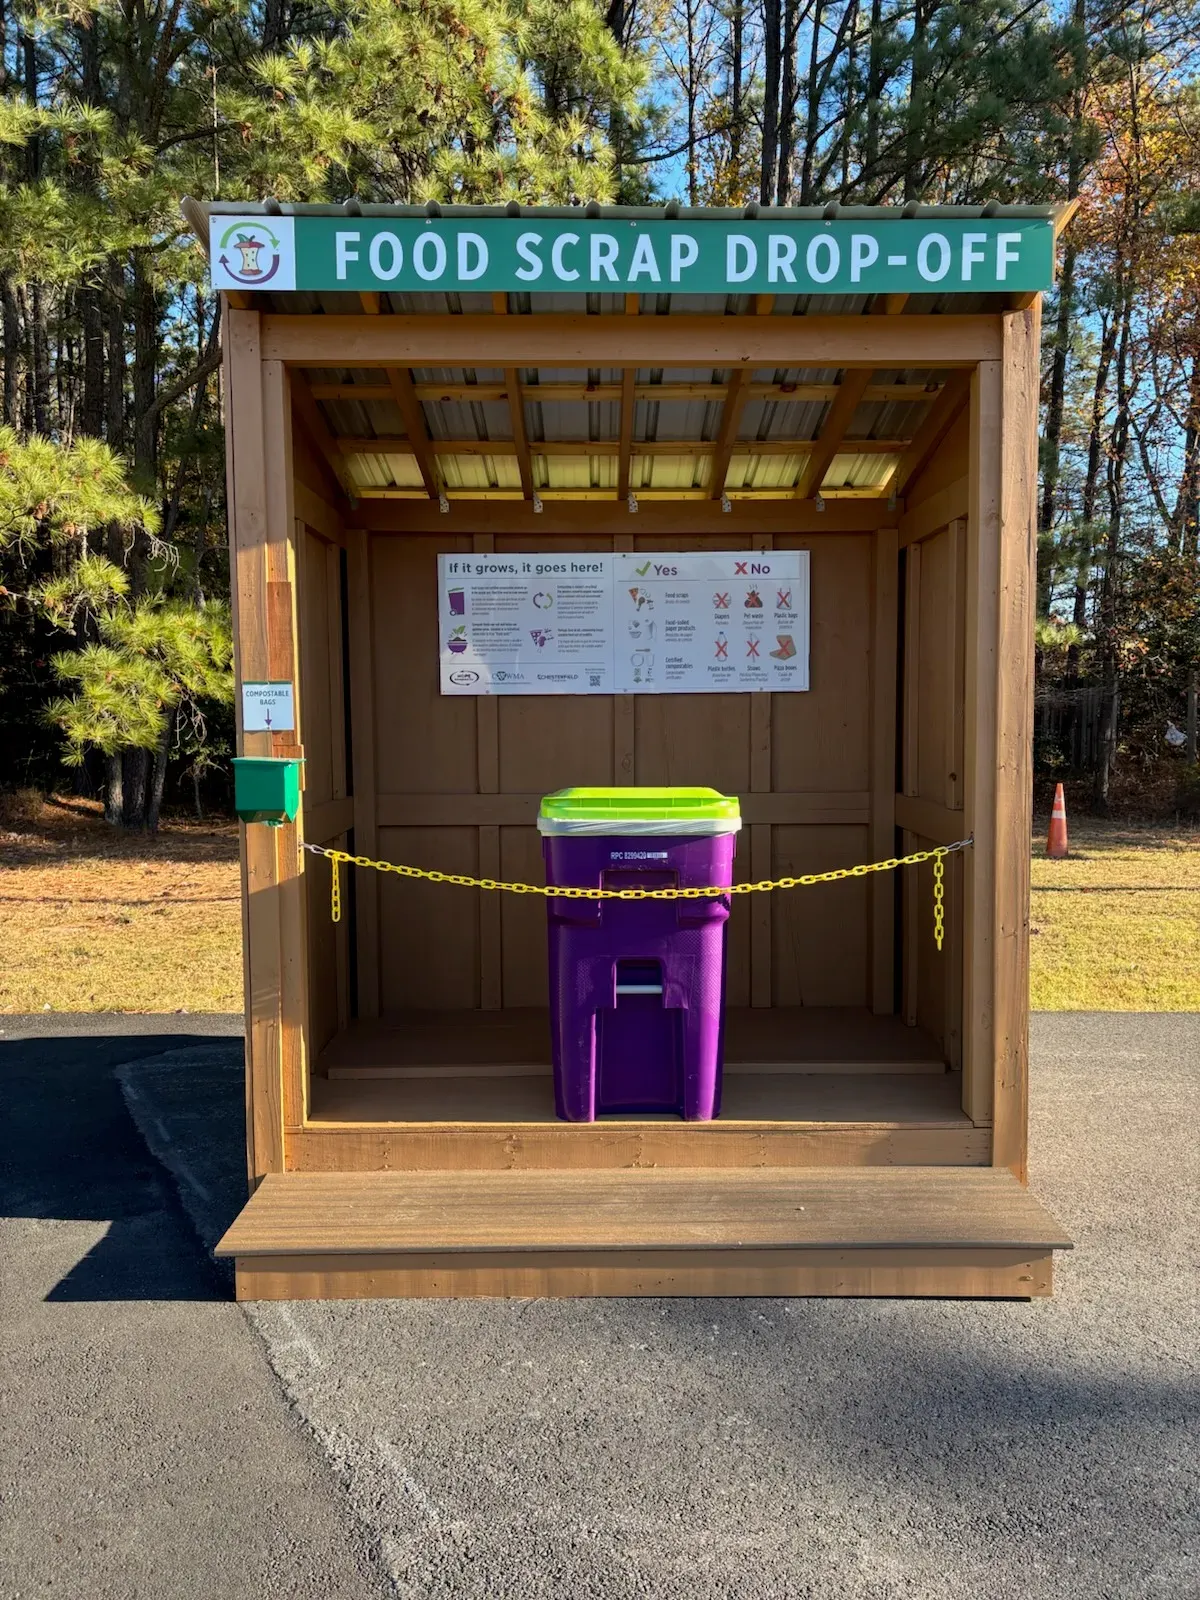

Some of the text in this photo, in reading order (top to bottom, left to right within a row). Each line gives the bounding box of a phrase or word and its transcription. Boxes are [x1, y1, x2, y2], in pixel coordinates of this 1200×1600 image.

[336, 231, 1023, 284] FOOD SCRAP DROP-OFF
[449, 562, 603, 575] If it grows, it goes here!
[654, 564, 678, 576] Yes
[751, 563, 771, 575] No
[610, 852, 623, 860] RPC
